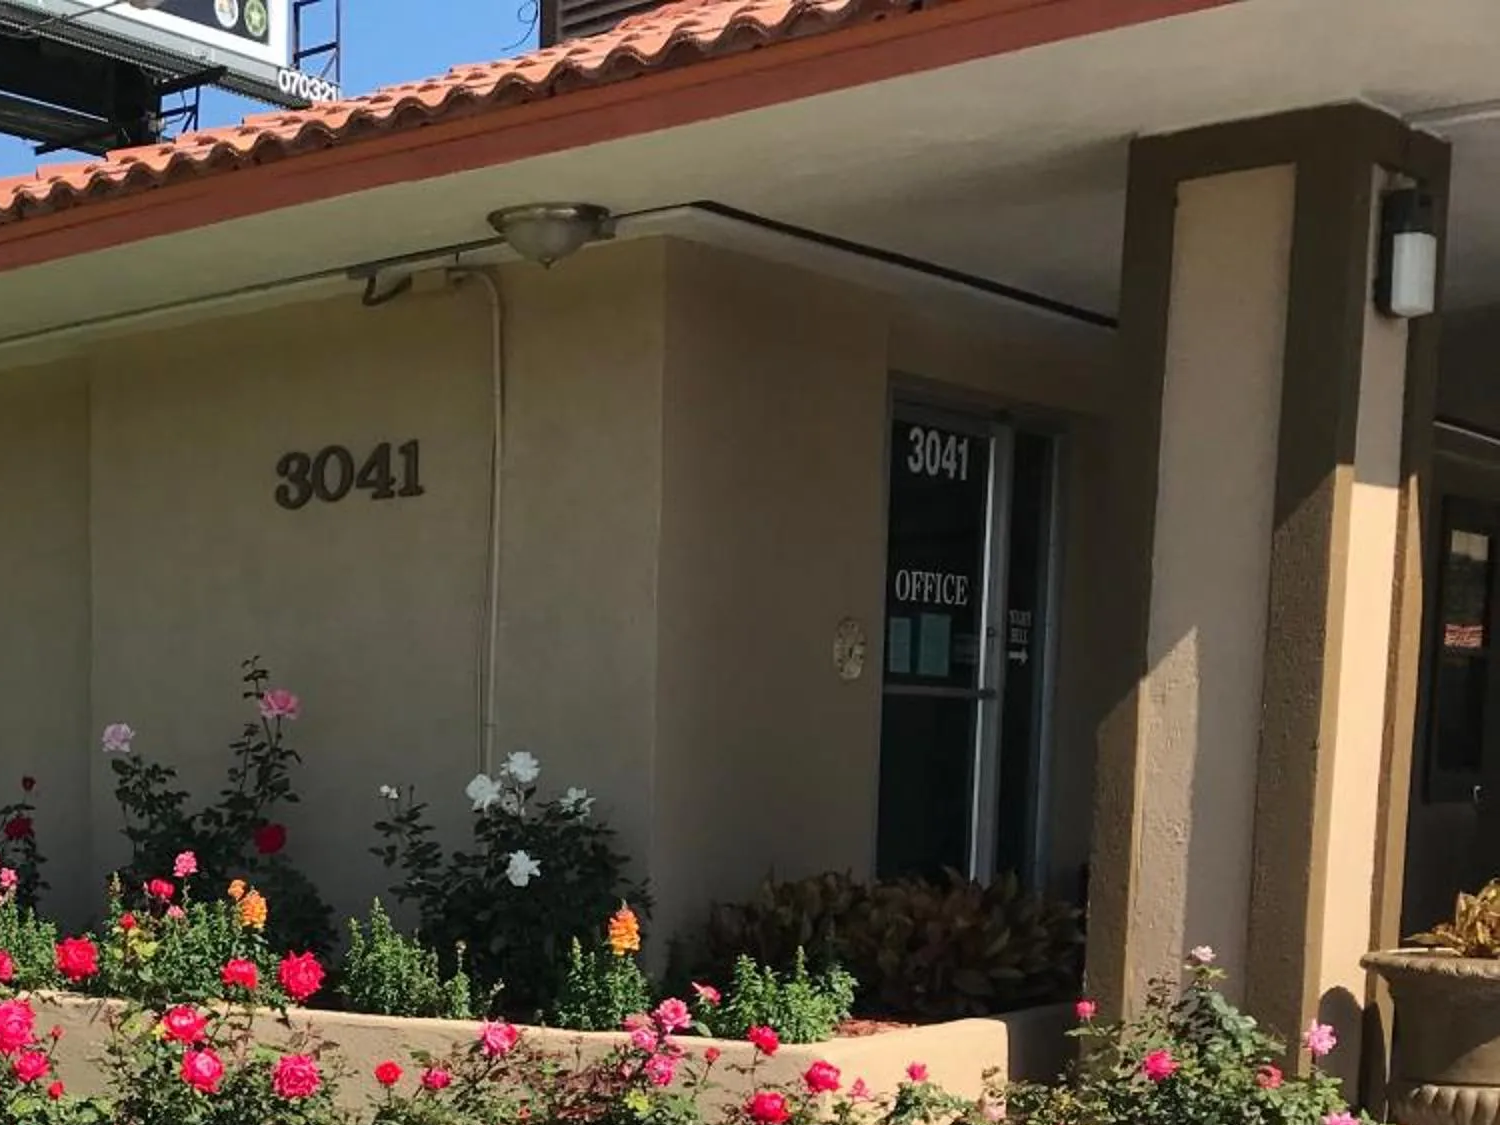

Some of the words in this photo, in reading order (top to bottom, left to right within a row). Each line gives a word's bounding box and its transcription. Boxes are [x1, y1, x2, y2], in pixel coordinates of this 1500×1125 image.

[275, 438, 425, 510] 3041
[907, 426, 968, 481] 3041
[895, 569, 968, 606] OFFICE
